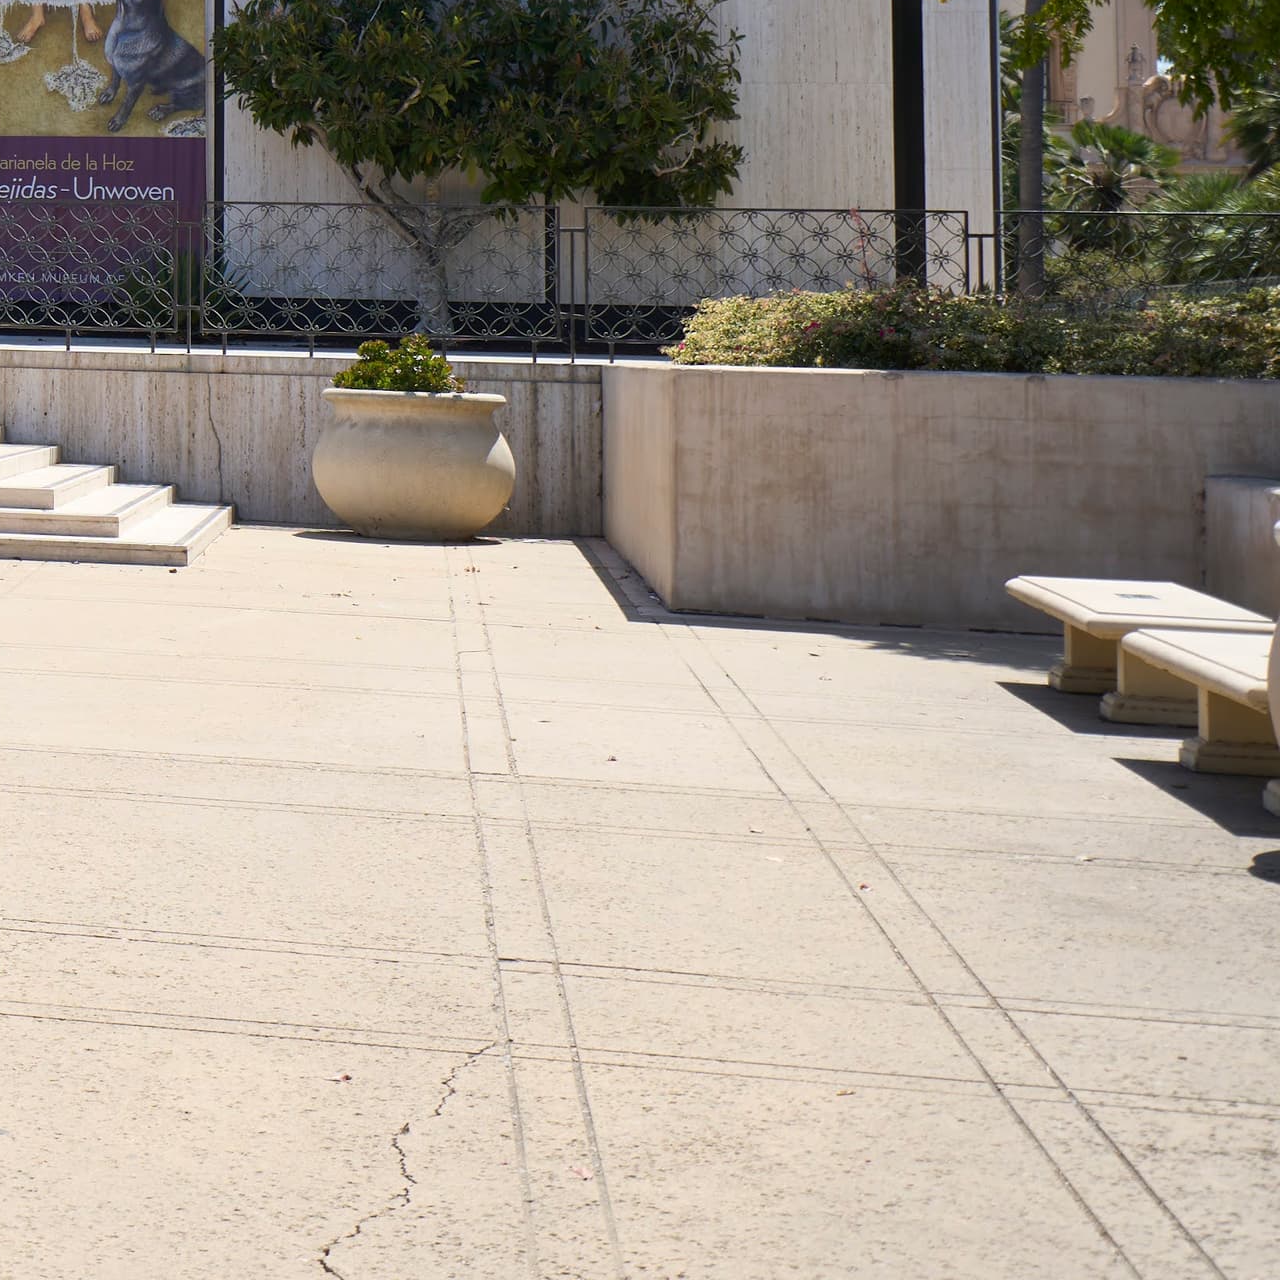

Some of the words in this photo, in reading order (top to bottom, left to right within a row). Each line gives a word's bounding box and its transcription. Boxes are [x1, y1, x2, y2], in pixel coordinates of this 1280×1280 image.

[60, 152, 81, 171] de
[85, 152, 98, 171] la
[102, 153, 135, 171] Hoz
[40, 272, 100, 284] MUSEUM
